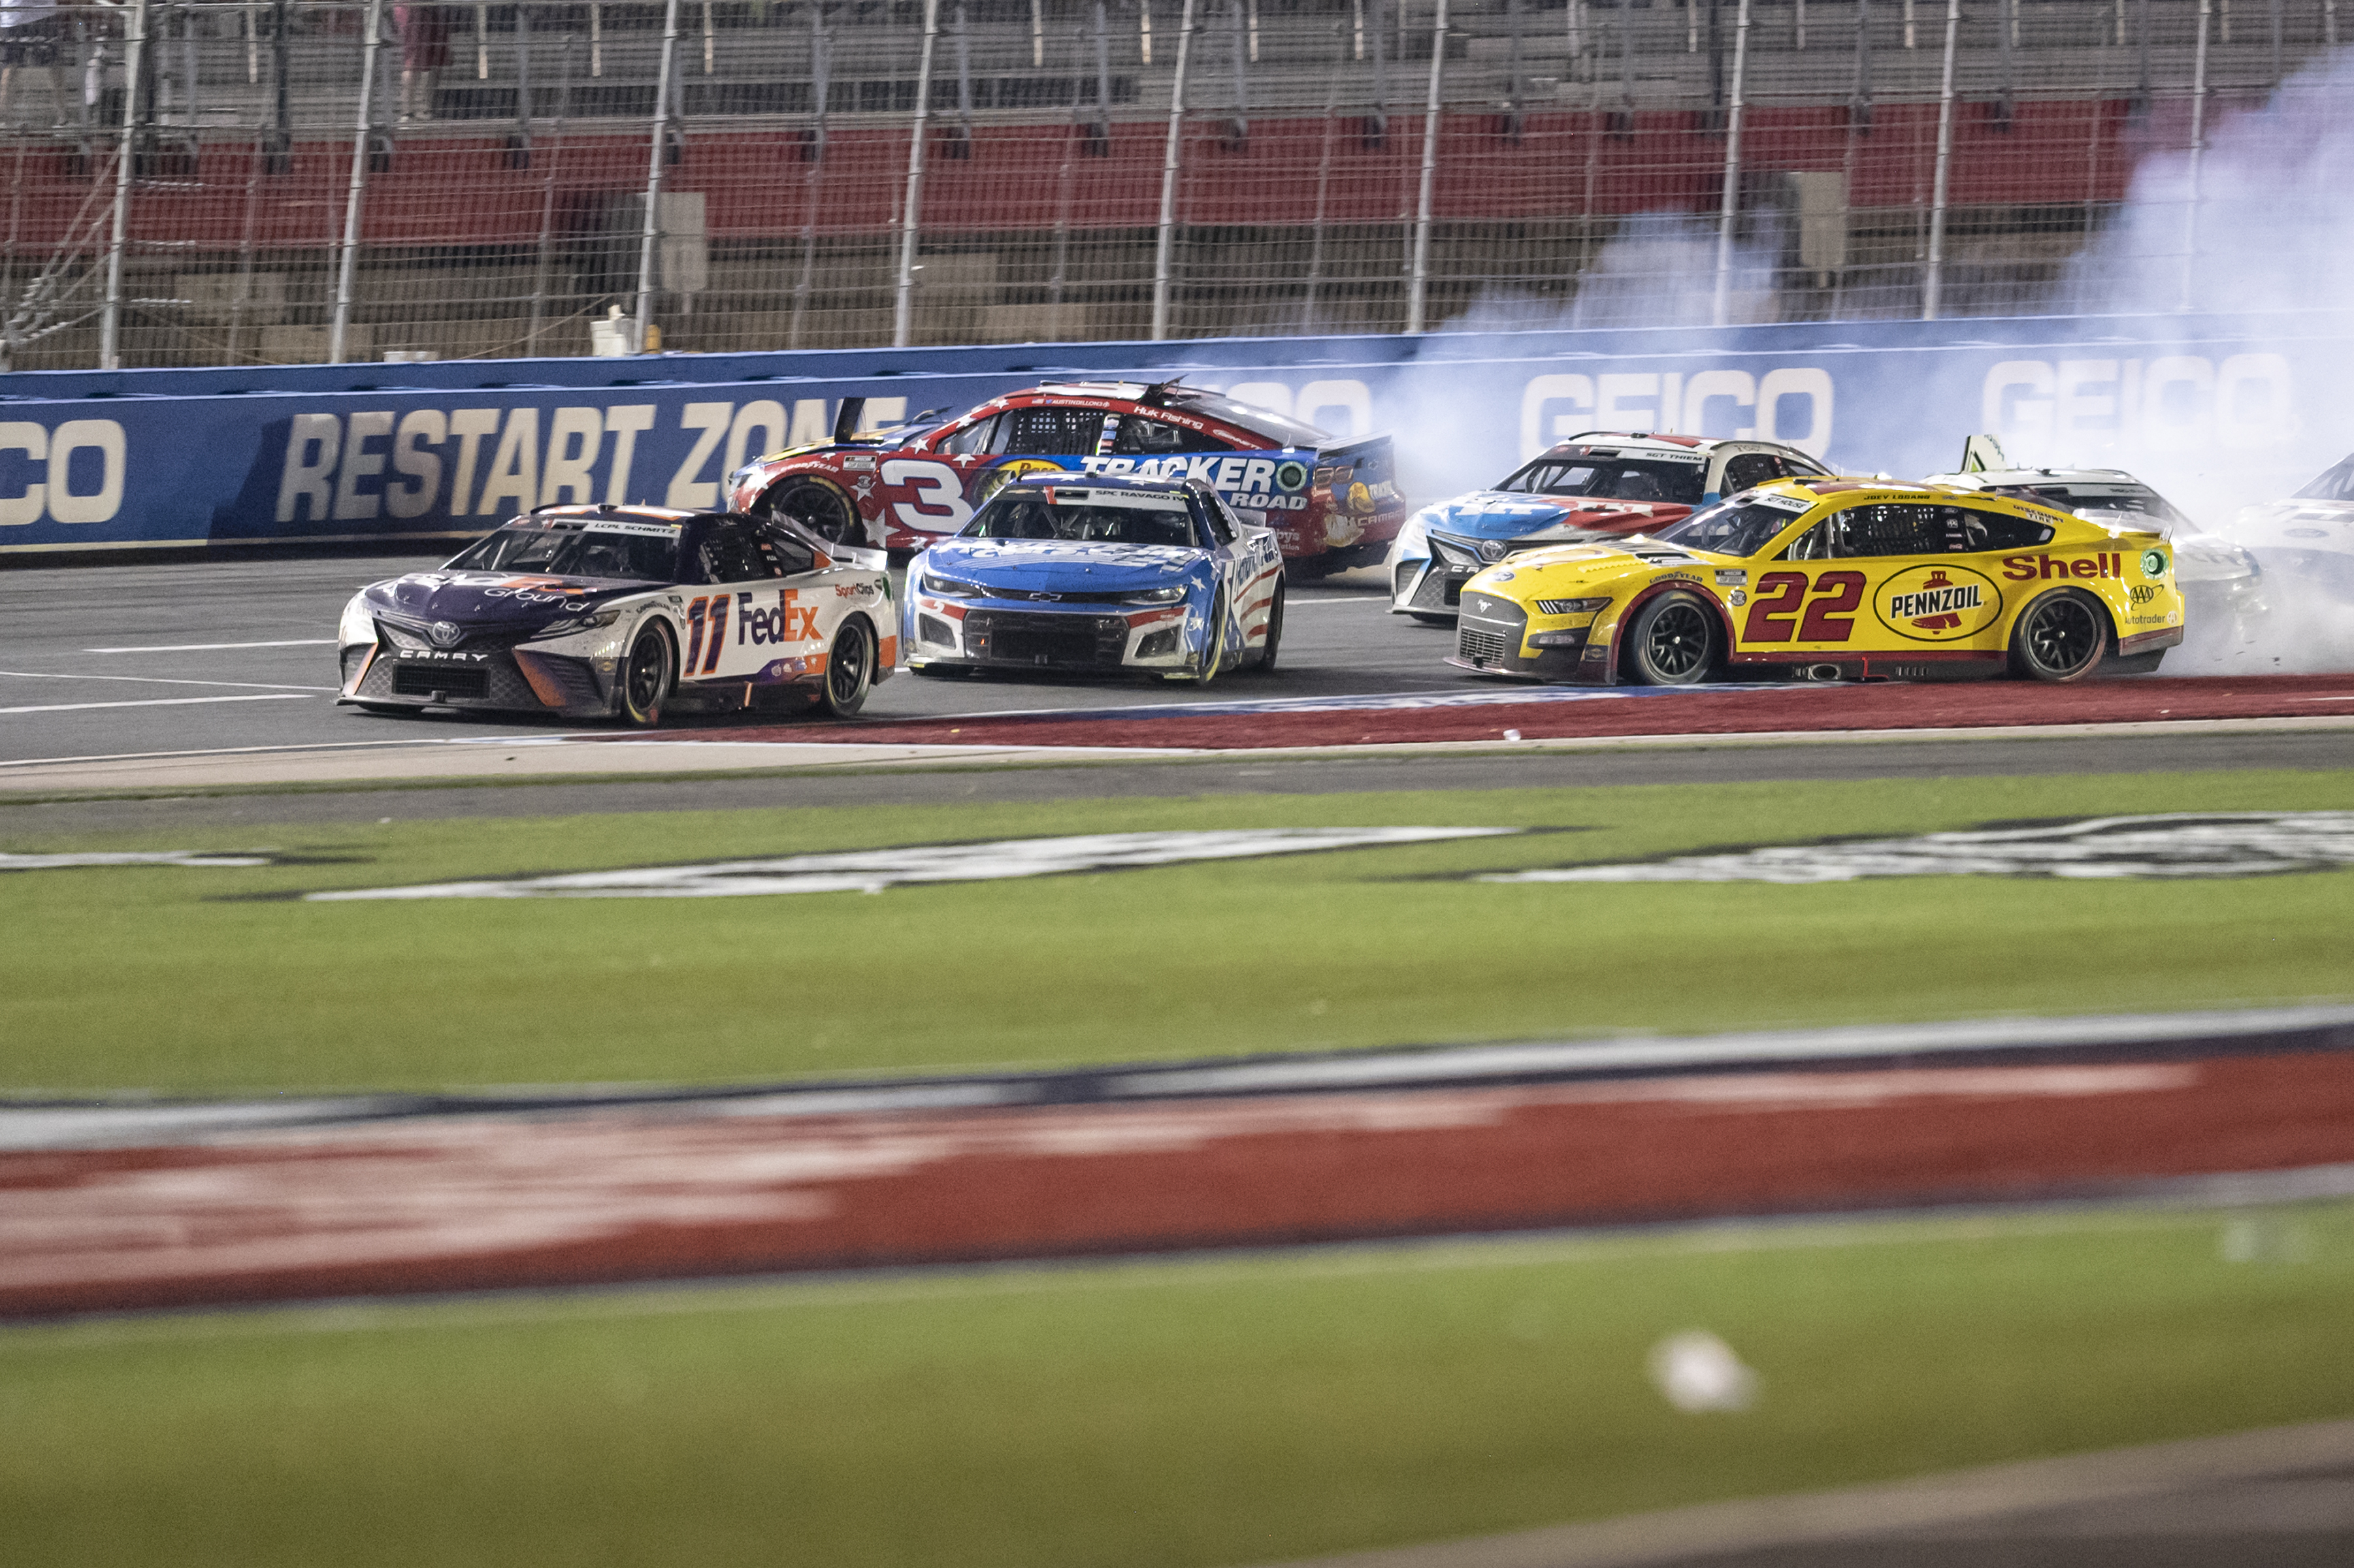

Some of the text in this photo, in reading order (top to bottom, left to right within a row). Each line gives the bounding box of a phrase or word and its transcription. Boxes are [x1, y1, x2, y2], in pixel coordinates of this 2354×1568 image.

[1134, 406, 1204, 429] Huk Fishing
[276, 404, 657, 522] RESTART
[1080, 456, 1275, 493] TRACKER
[880, 459, 975, 534] 3
[1228, 493, 1308, 510] ROAD
[1778, 498, 1807, 508] HOUSE
[2013, 504, 2064, 523] DISCOUNT
[624, 525, 676, 534] SCHMITZ
[2003, 553, 2121, 581] Shell
[484, 588, 590, 612] Ground
[1891, 584, 1983, 619] PENNZOIL
[2131, 585, 2153, 603] AAA
[737, 589, 824, 645] FedEx
[1741, 571, 1867, 643] 22
[2125, 614, 2166, 625] Autotrader
[683, 593, 731, 677] 11
[400, 649, 488, 661] CAMRY
